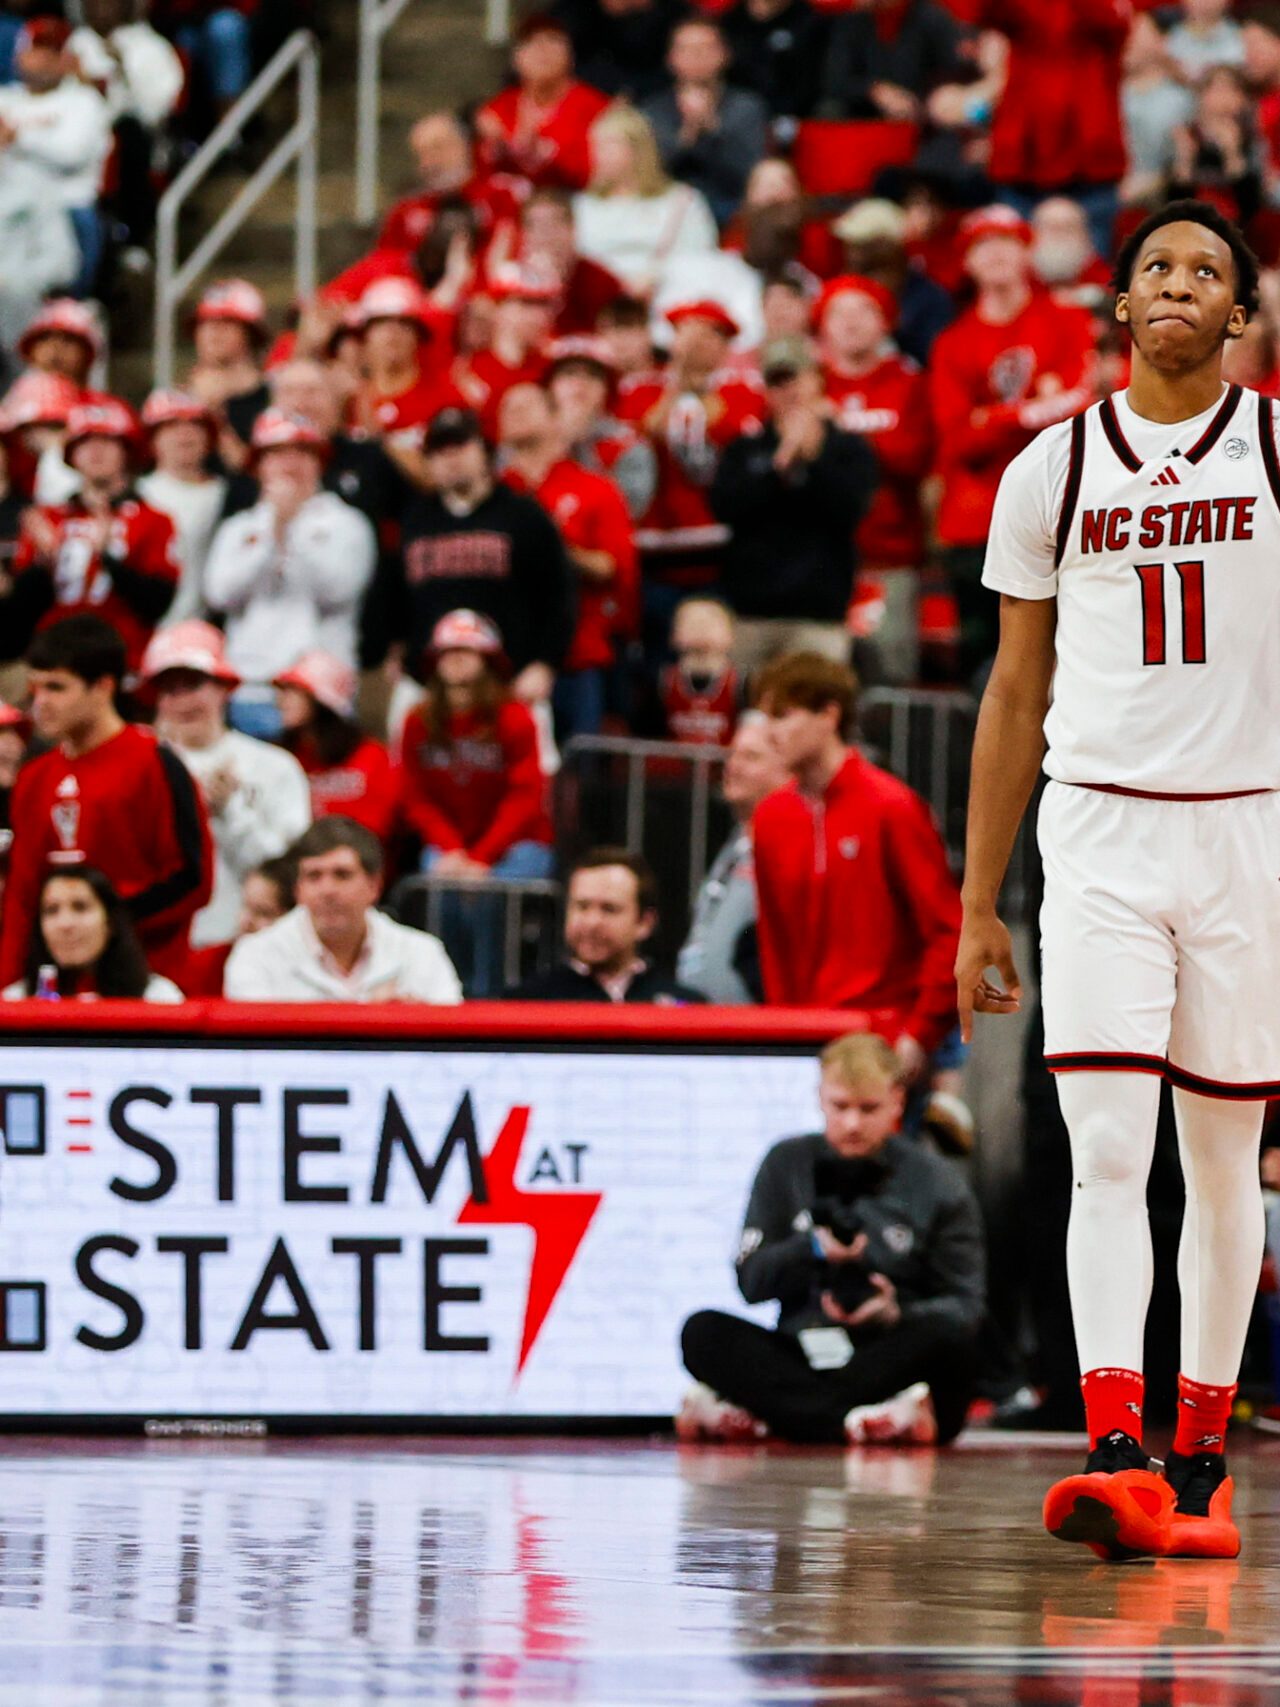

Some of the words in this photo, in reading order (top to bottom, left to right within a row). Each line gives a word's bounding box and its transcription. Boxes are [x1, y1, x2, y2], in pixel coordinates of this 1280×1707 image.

[1081, 507, 1133, 554] NC
[1138, 496, 1259, 549] STATE
[1133, 560, 1207, 666] 11
[107, 1086, 491, 1205] STEM
[529, 1144, 590, 1183] AT
[74, 1234, 490, 1352] STATE
